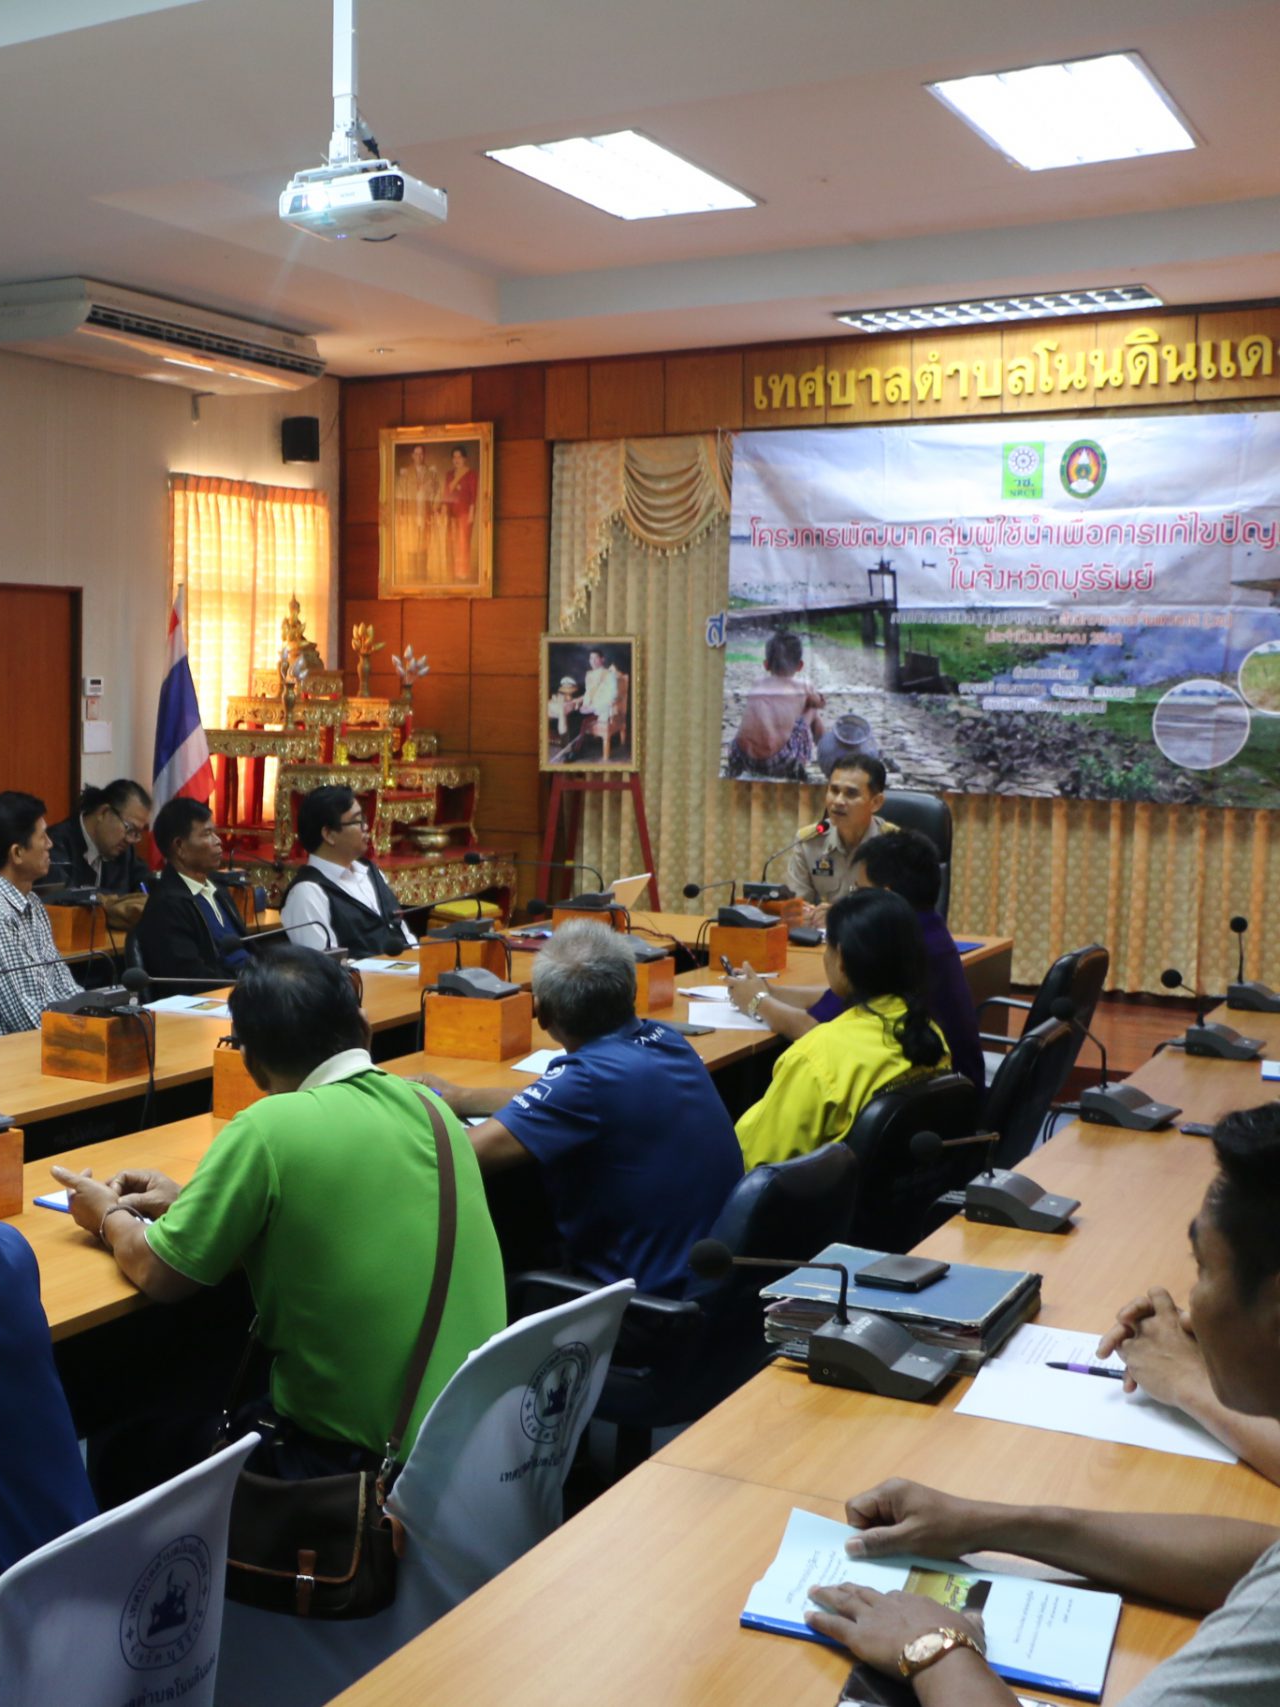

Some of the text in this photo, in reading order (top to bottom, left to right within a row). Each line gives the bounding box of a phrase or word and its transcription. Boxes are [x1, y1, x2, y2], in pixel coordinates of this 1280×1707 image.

[753, 327, 1280, 410] เทศบาลตำบลโนนดินแด
[750, 511, 1280, 554] โครงการพัฒนากลุ่มผู้ใช้น้ำเพื่อการแก้ไขปัญ
[948, 557, 1154, 598] ในจังหวัดบุรีรัมย์
